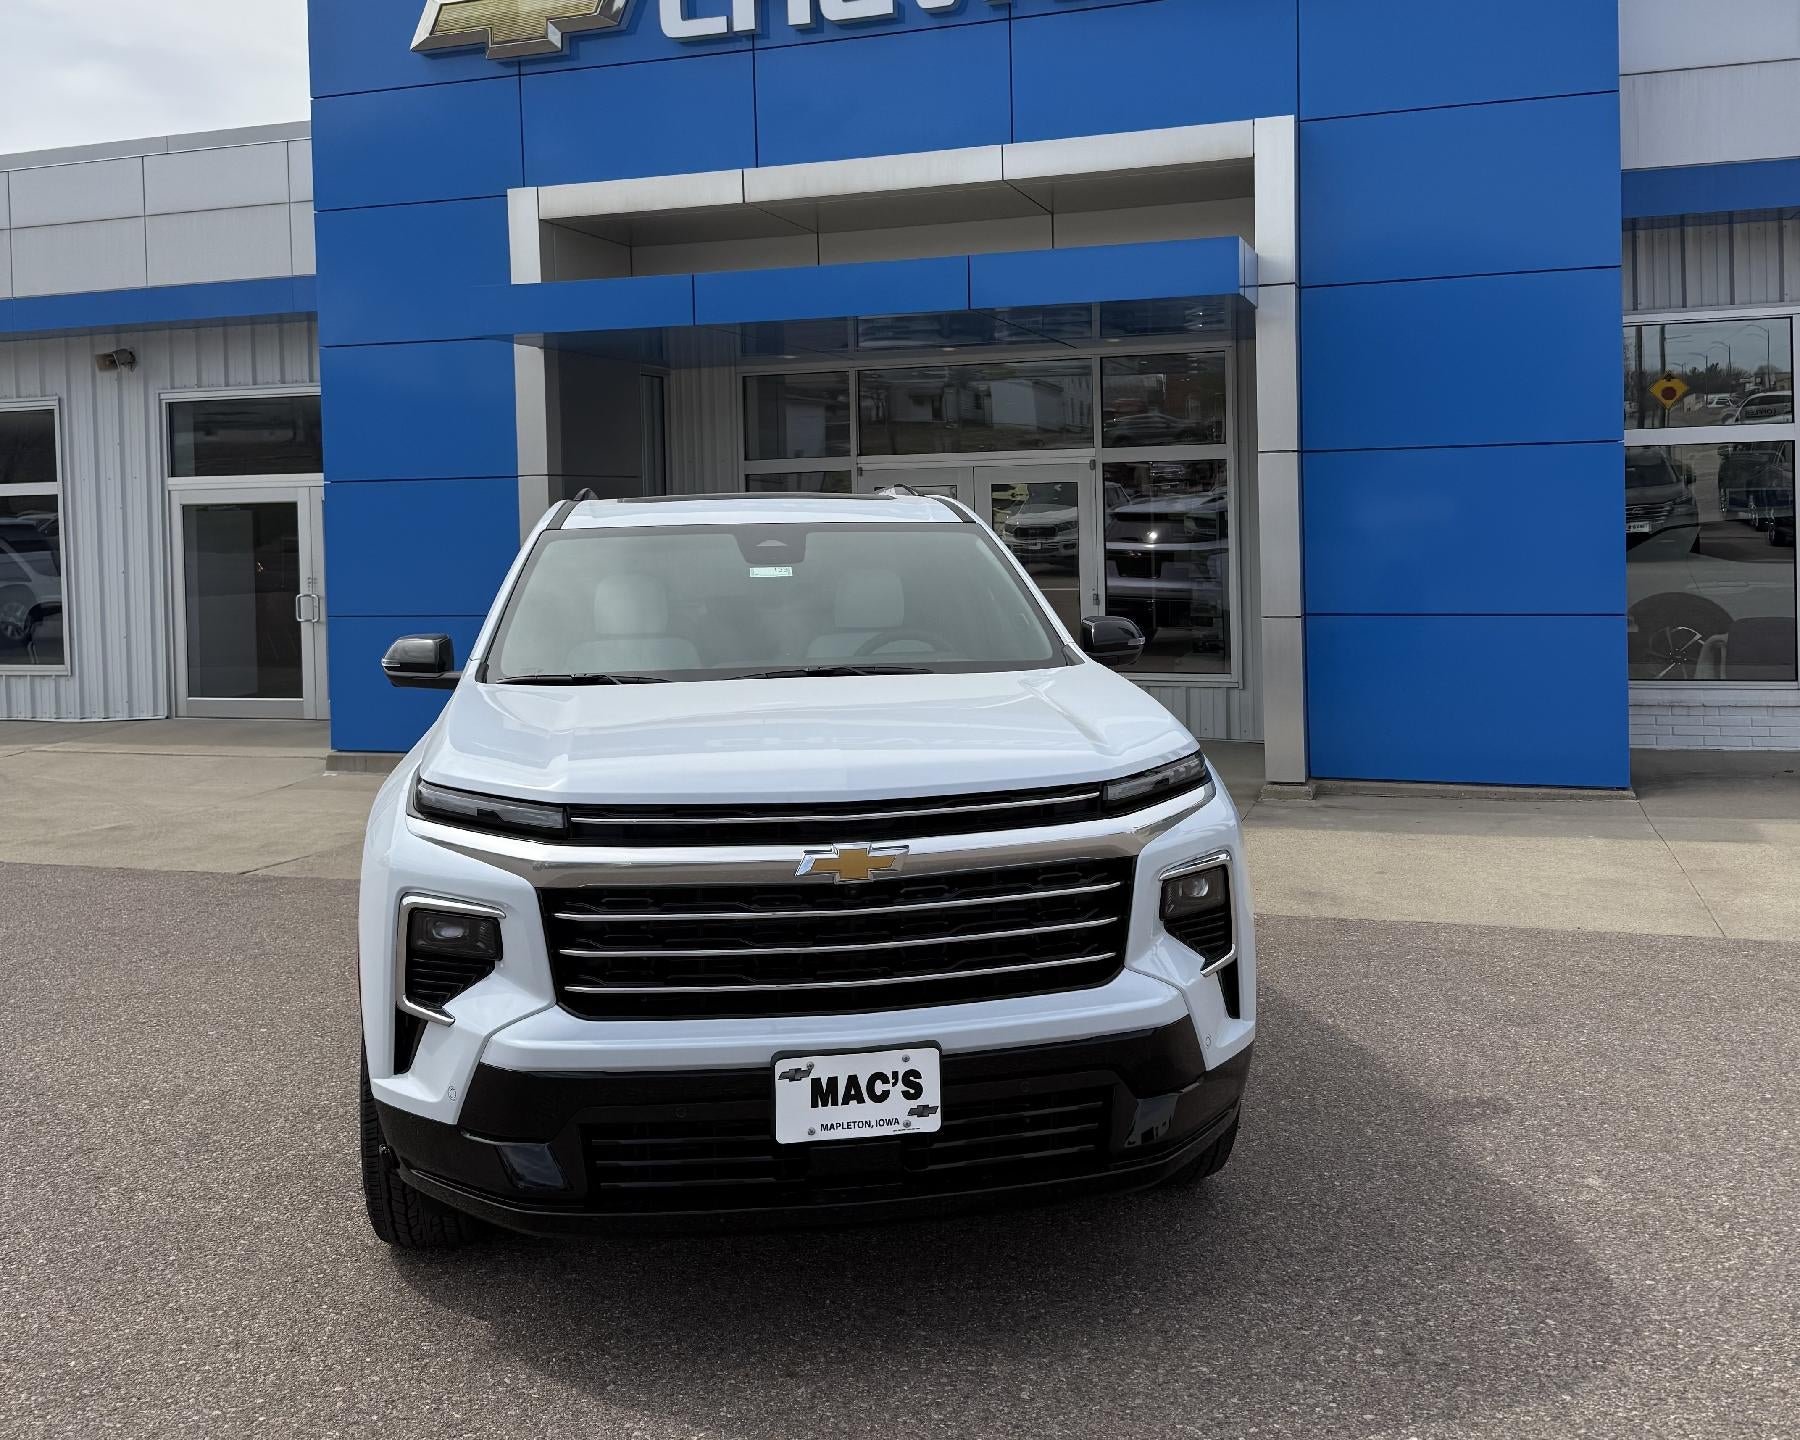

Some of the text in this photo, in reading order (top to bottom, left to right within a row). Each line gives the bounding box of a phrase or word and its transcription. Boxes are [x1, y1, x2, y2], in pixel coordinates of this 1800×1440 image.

[810, 1068, 924, 1108] MAC'S
[820, 1117, 900, 1132] MAPLETON, IOWA
